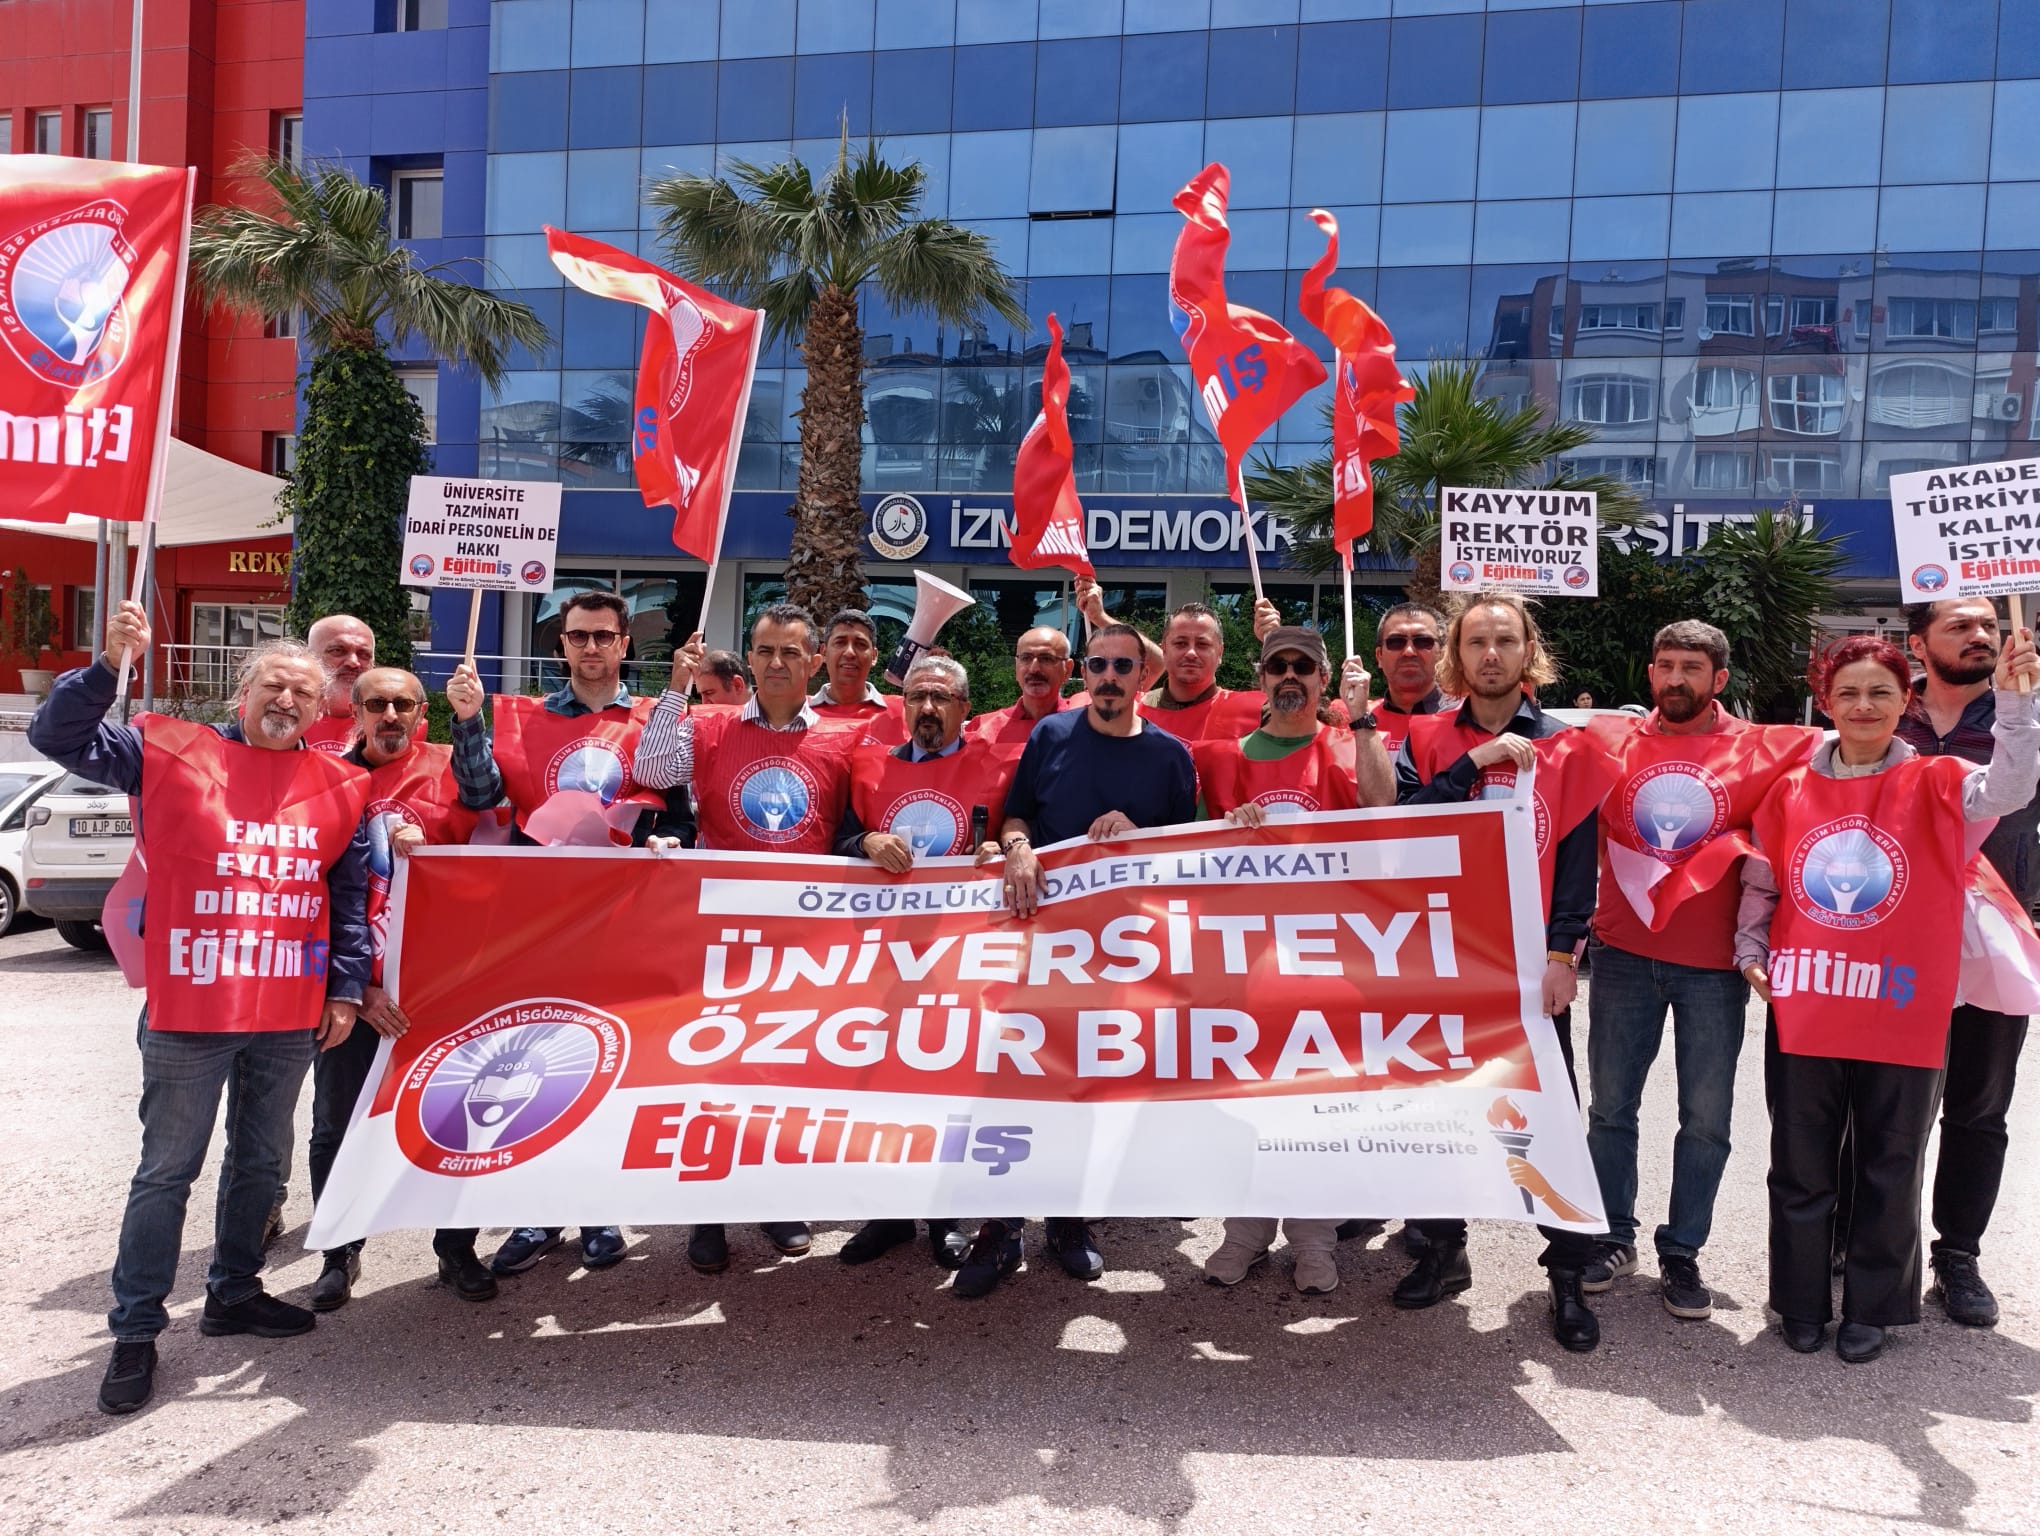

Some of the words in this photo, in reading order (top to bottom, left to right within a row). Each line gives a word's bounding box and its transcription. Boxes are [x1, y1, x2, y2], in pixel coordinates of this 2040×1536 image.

[1926, 464, 2038, 491] AKADE
[443, 483, 525, 502] ÜNİVERSİTE
[1447, 492, 1591, 516] KAYYUM
[445, 503, 519, 520] TAZMİNATI
[407, 517, 445, 535] İDARİ
[448, 522, 534, 540] PERSONELİN
[537, 528, 556, 541] DE
[1449, 520, 1589, 546] REKTÖR
[1938, 513, 2040, 537] KALM
[457, 542, 500, 556] HAKKI
[1456, 543, 1582, 565] İSTEMİYORUZ
[1948, 536, 2040, 560] İSTİY
[77, 821, 87, 832] 10
[93, 821, 109, 832] AJP
[115, 820, 132, 832] 604
[225, 819, 319, 850] EMEK
[216, 852, 322, 882] EYLEM
[798, 884, 1001, 912] ÖZGÜRLÜK,
[1043, 861, 1160, 900] DALET,
[1177, 851, 1349, 878] LİYAKAT!
[194, 886, 323, 922] DİRENİŞ
[702, 892, 1460, 999] ÜNİVERSİTEYİ
[667, 994, 1046, 1077] ÖZGÜR
[1076, 1007, 1474, 1080] BIRAK!
[409, 1046, 447, 1090] EĞİTİM
[446, 1032, 468, 1048] VE
[469, 1014, 513, 1037] BİLİM
[496, 1060, 531, 1073] 2005
[621, 1101, 1033, 1181] Eğitimiş
[1257, 1137, 1350, 1153] Bilimsel
[1357, 1136, 1479, 1156] Üniversite
